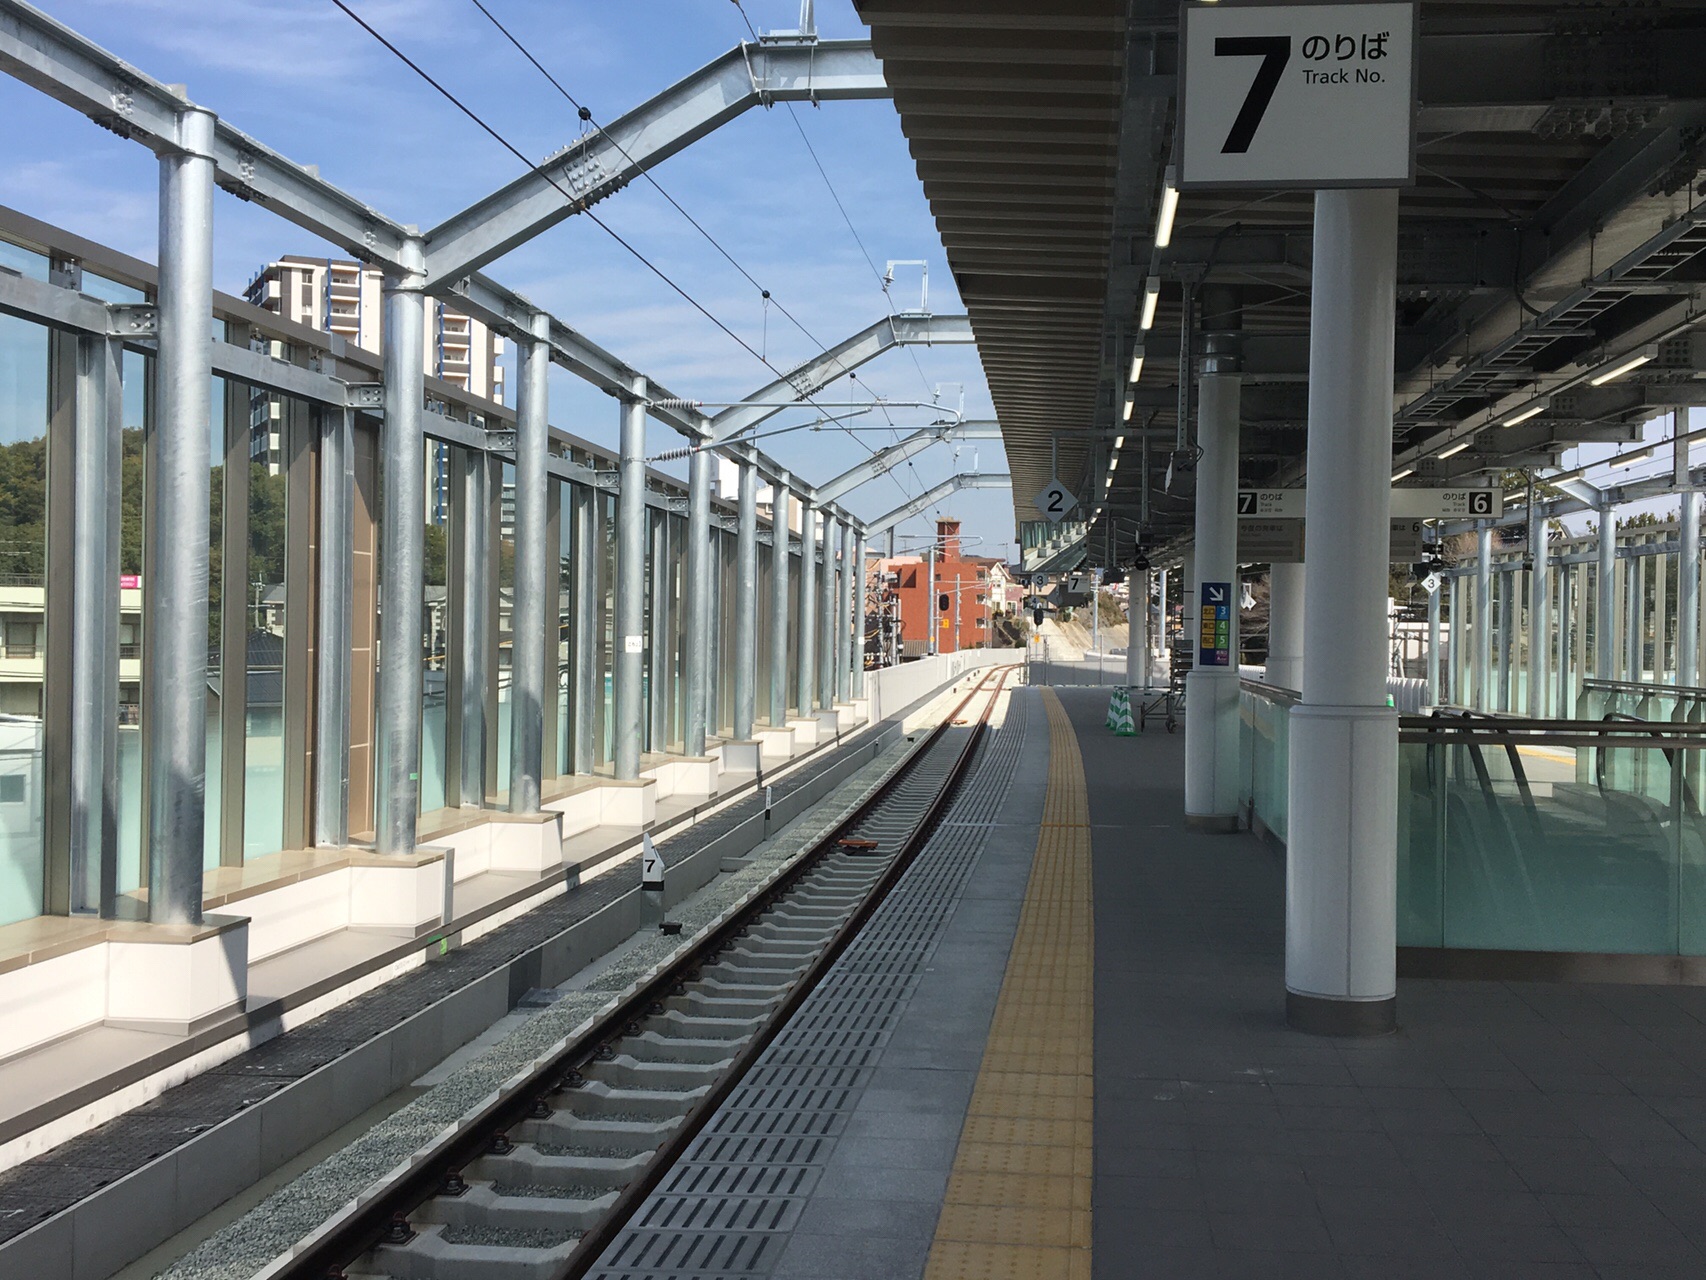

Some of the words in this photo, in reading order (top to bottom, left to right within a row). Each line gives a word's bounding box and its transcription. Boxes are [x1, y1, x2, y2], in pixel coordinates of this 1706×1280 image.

[1302, 31, 1390, 61] のりば
[1302, 68, 1349, 84] Track
[1355, 68, 1385, 83] No.
[1214, 36, 1291, 154] 7
[1047, 490, 1063, 513] 2
[1260, 493, 1283, 501] のりば
[1442, 492, 1466, 501] のりば
[1239, 494, 1252, 513] 7
[1474, 493, 1488, 513] 6
[1412, 521, 1420, 532] 6
[1036, 575, 1044, 585] 3
[1070, 578, 1079, 590] 7
[1428, 578, 1435, 588] 3
[1220, 606, 1226, 615] 3
[1219, 621, 1226, 629] 4
[1220, 635, 1226, 644] 5
[644, 860, 656, 873] 7
